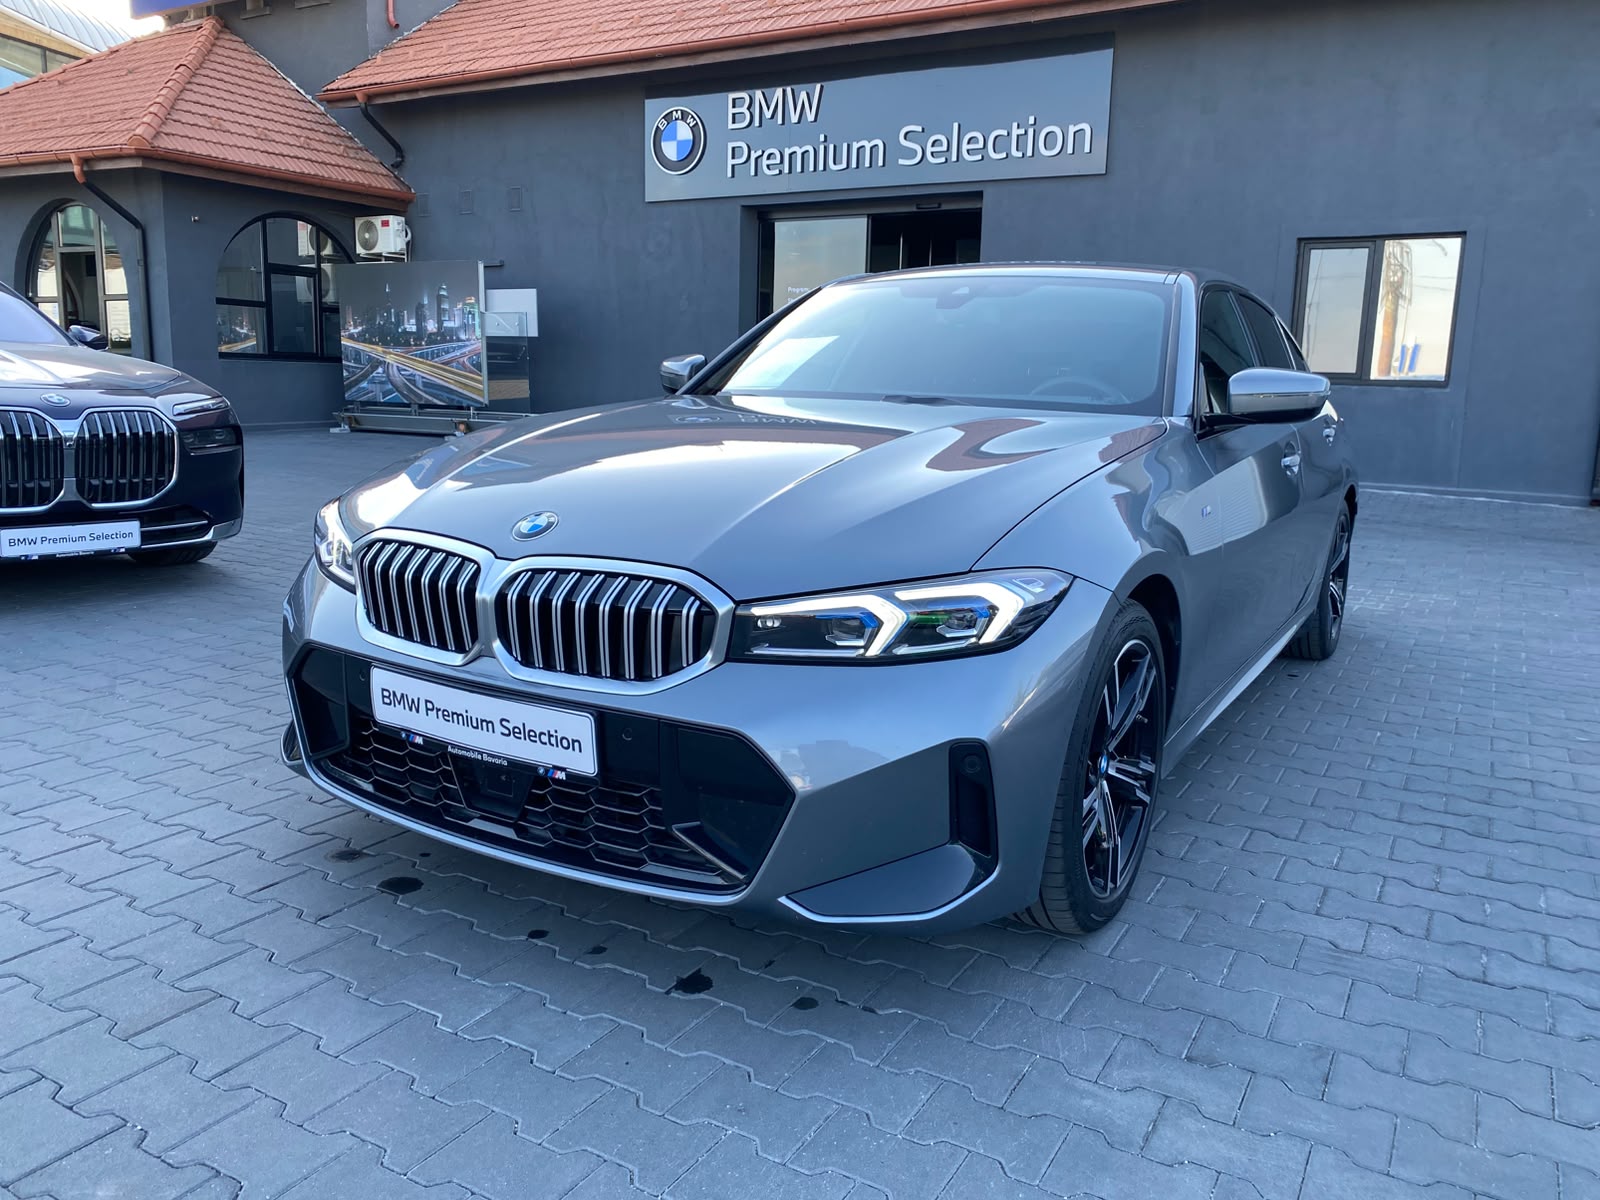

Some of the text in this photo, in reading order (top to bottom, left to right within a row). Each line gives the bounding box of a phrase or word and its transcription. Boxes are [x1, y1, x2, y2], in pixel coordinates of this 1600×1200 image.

[657, 110, 697, 131] BMW
[727, 83, 824, 131] BMW
[726, 115, 1093, 178] Premium Selection
[8, 530, 134, 547] BMW Premium Selection
[381, 687, 583, 753] BMW Premium Selection
[447, 745, 508, 766] Automobile Bavaria
